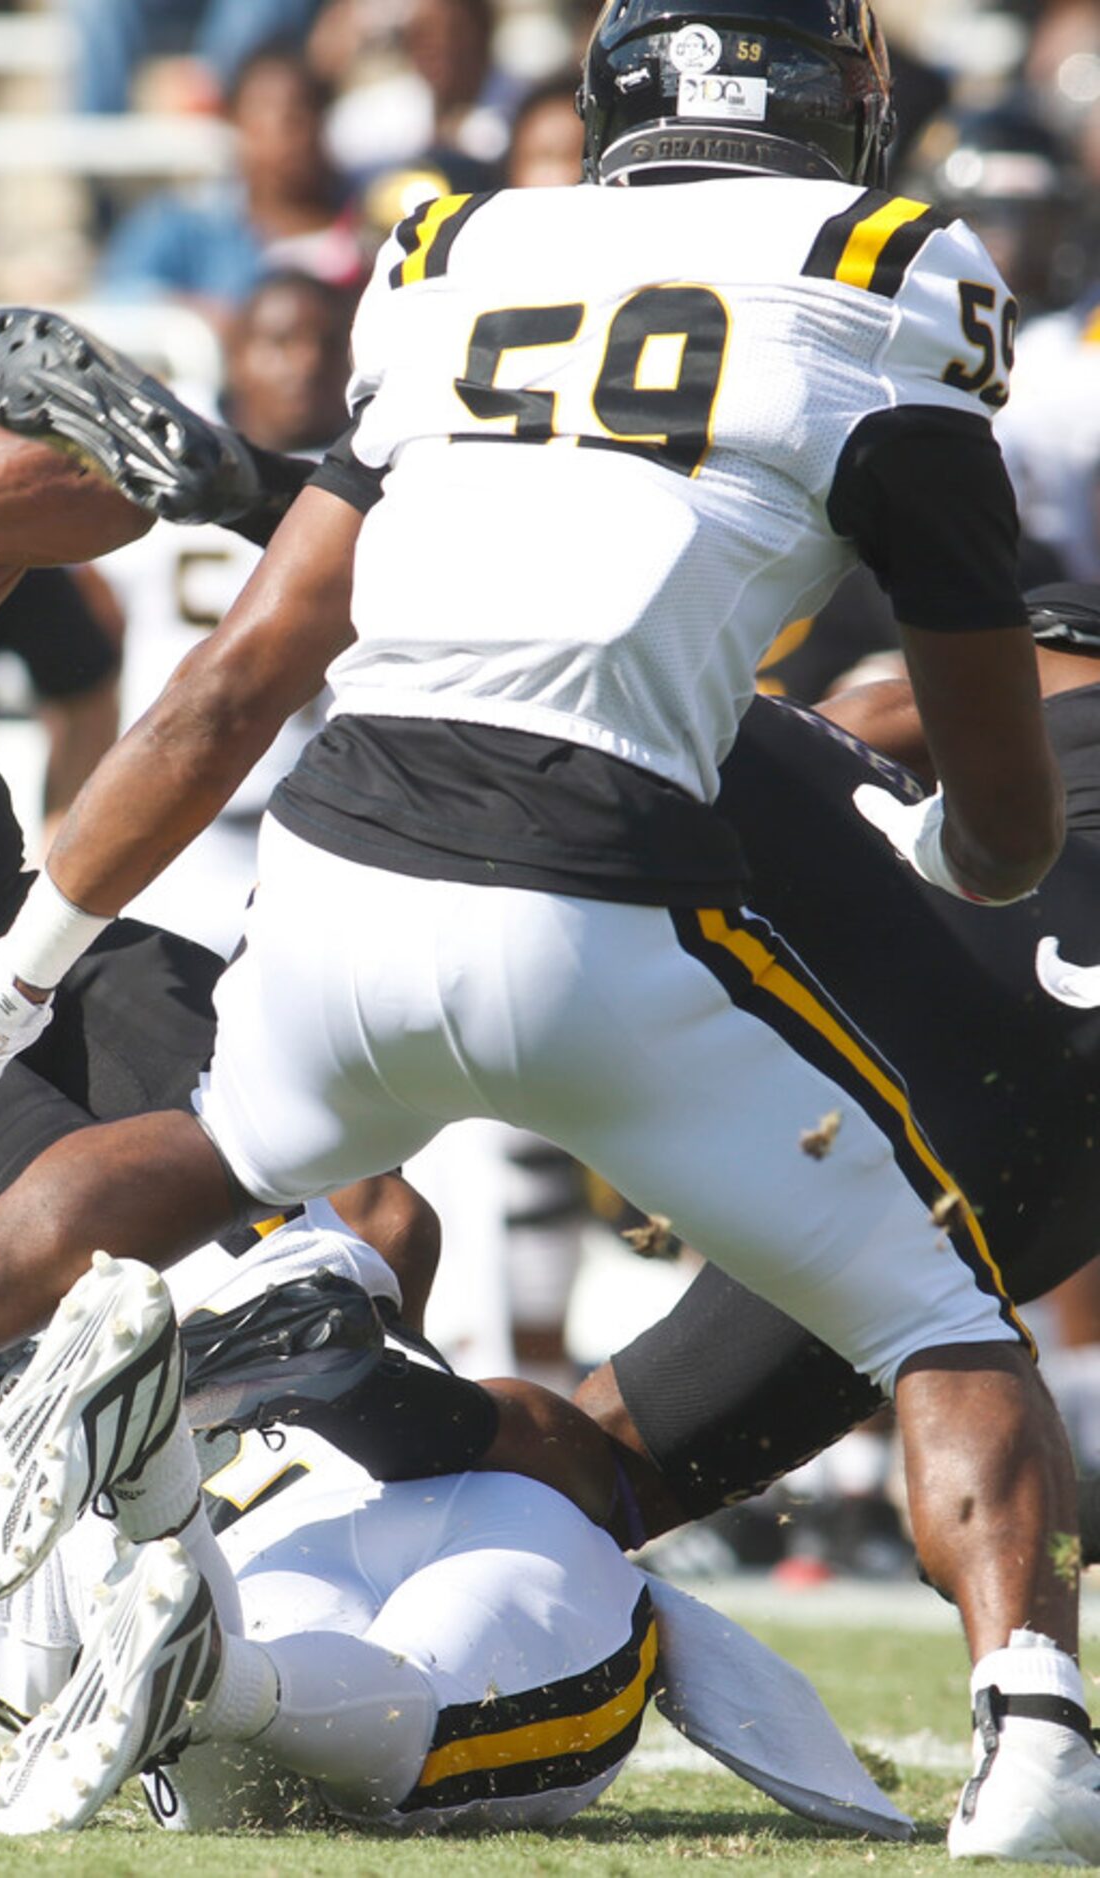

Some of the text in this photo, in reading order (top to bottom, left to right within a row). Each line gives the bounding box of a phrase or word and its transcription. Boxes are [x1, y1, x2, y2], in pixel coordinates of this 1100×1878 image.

[737, 41, 762, 61] 59
[658, 136, 790, 164] GRAMBLI
[449, 282, 731, 478] 59
[941, 280, 1018, 407] 59
